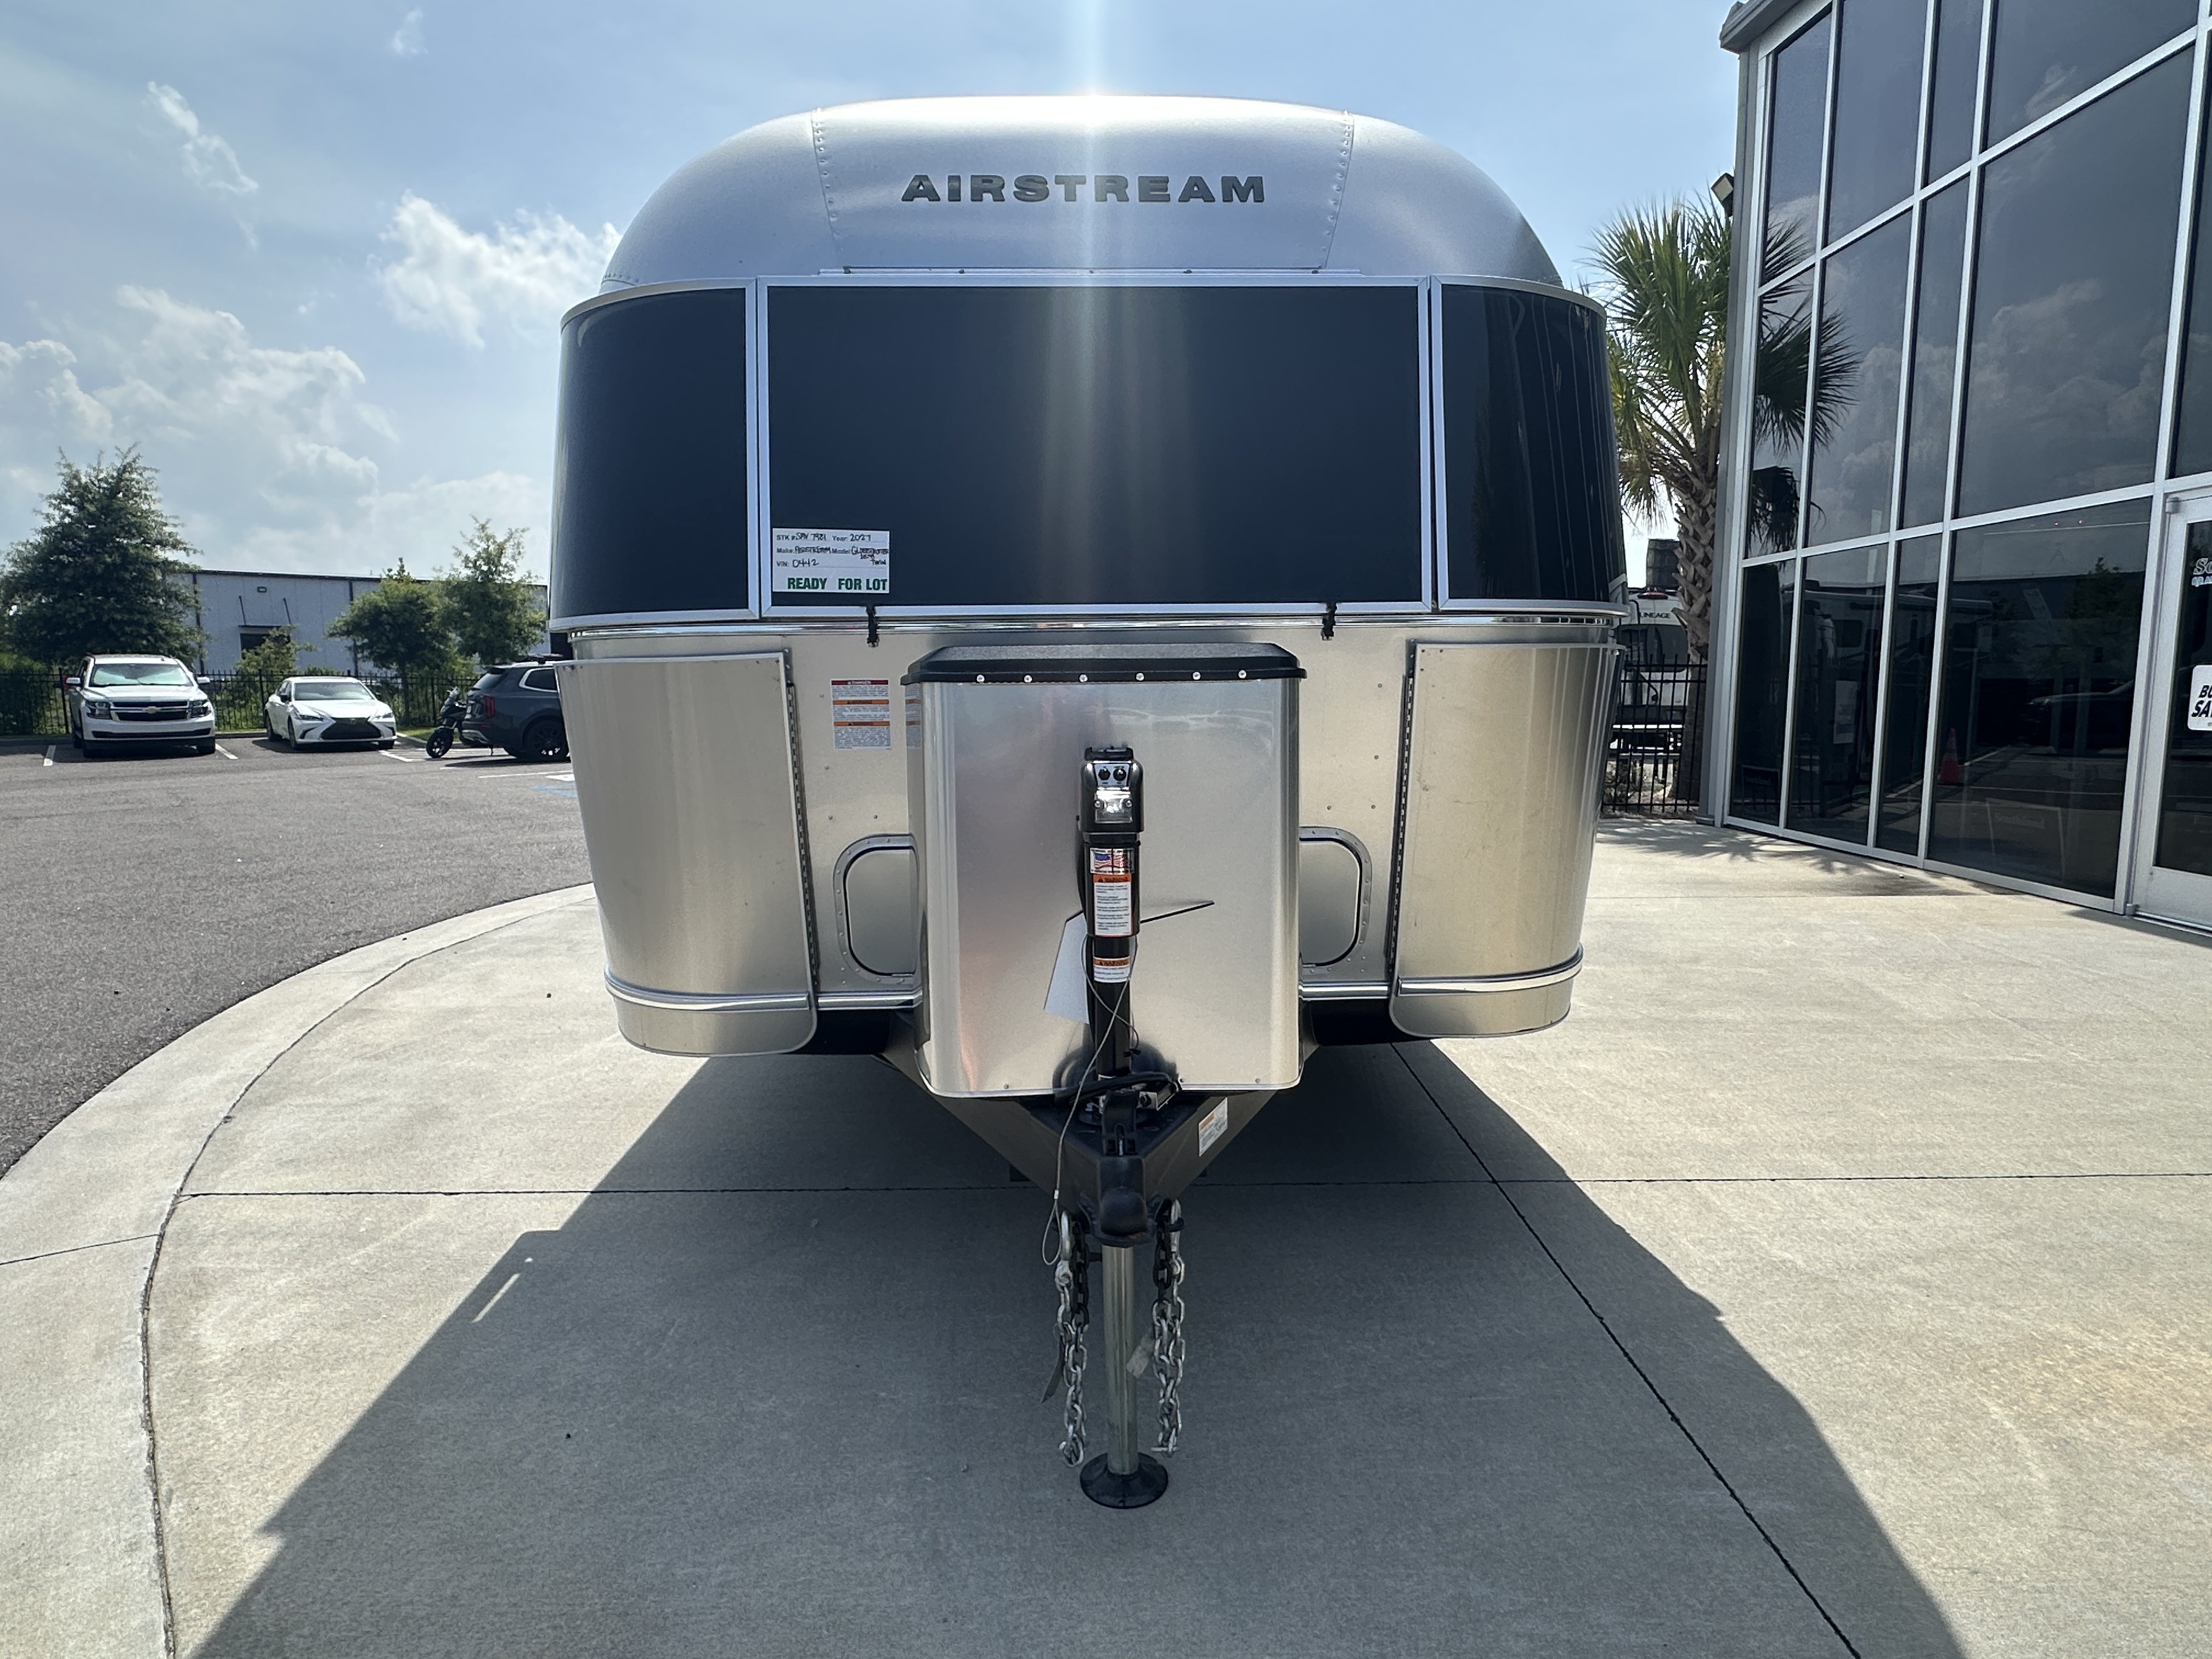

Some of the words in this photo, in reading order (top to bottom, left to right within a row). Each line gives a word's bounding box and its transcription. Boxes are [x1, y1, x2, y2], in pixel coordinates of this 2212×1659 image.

[901, 174, 1265, 203] AIRSTREAM
[787, 577, 827, 590] READY
[838, 578, 862, 590] FOR
[866, 578, 888, 591] LOT
[2191, 700, 2212, 718] SA
